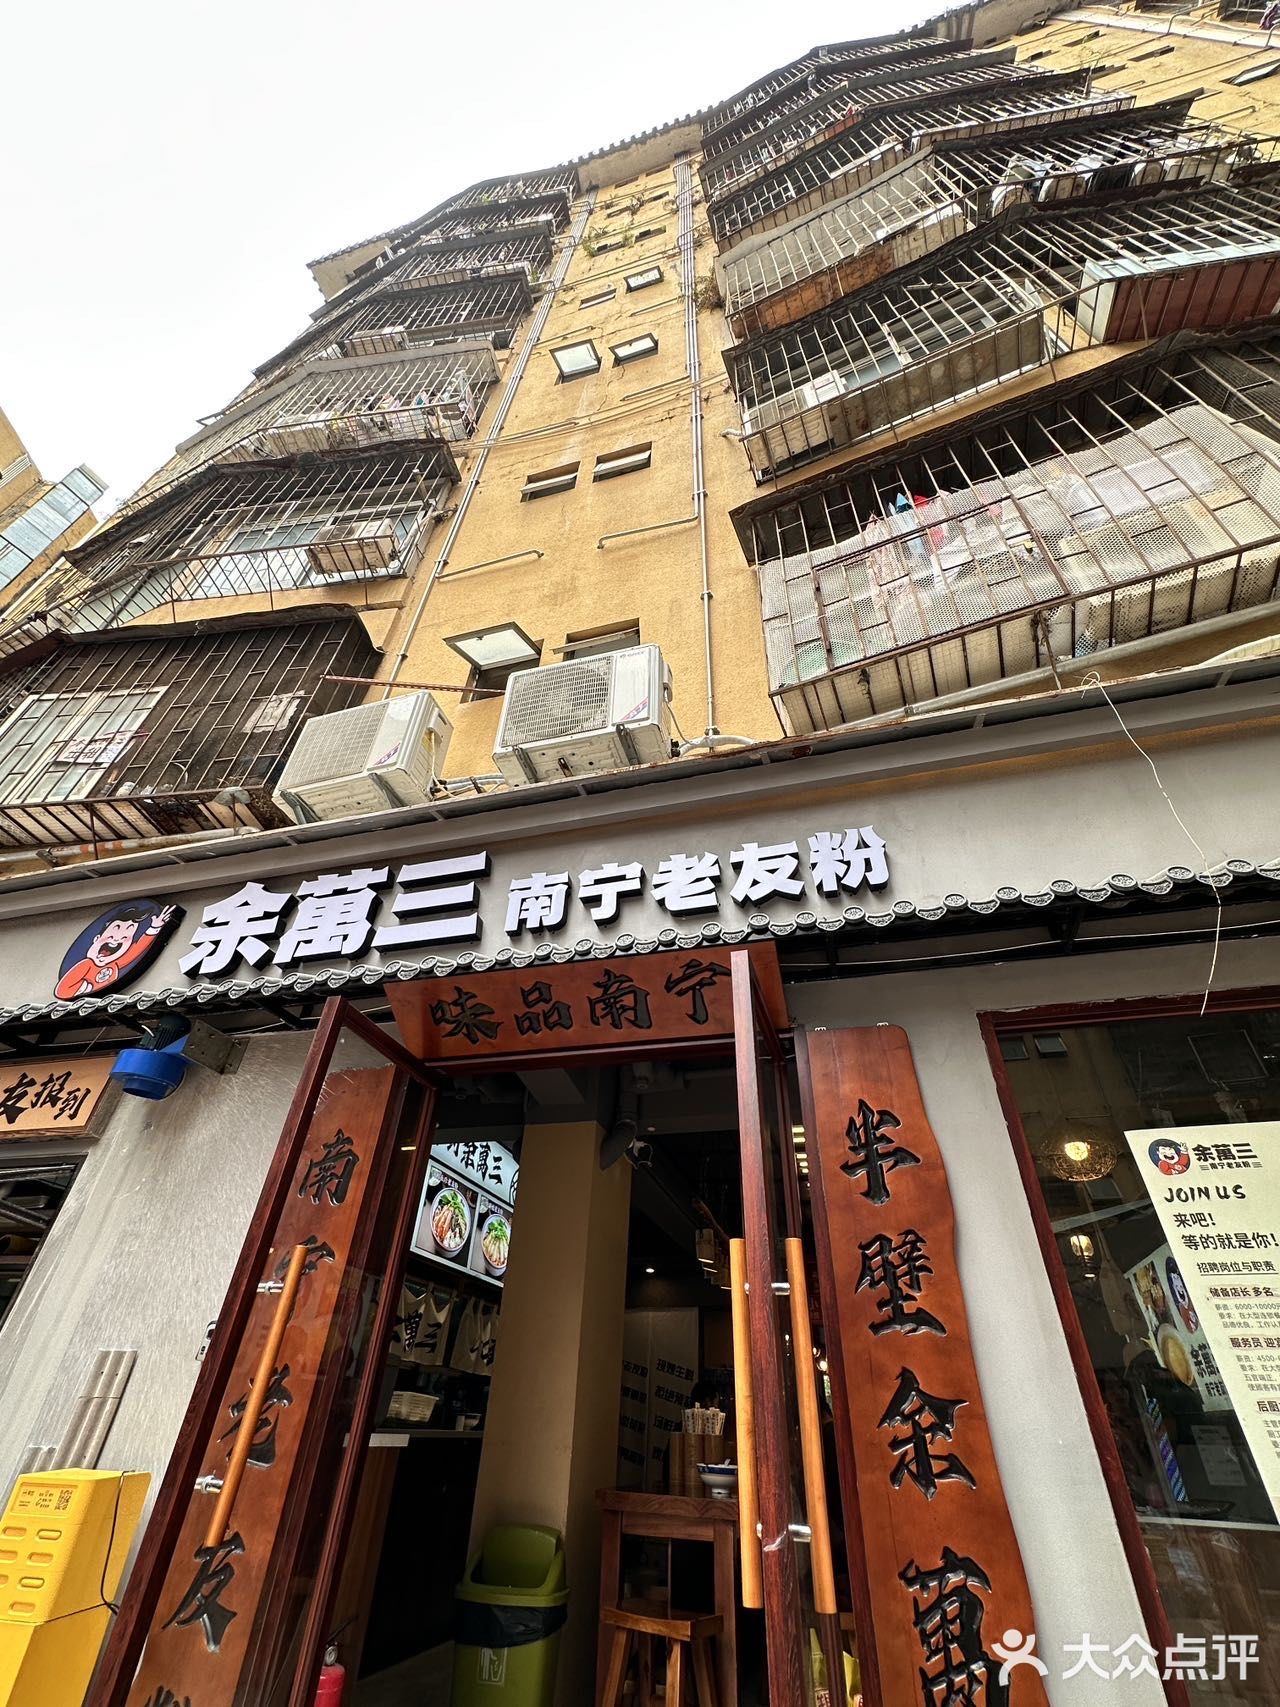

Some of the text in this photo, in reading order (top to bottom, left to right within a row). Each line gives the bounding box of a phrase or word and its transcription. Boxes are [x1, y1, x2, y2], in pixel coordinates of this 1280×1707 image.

[178, 825, 892, 977] 余萬三 南宁老友粉
[430, 957, 732, 1044] 味品南宁
[1192, 1142, 1258, 1162] 余萬三
[1164, 1184, 1247, 1203] JOIN US
[1197, 1260, 1277, 1274] 招聘岗位与职责
[145, 1128, 360, 1707] 南宁老友
